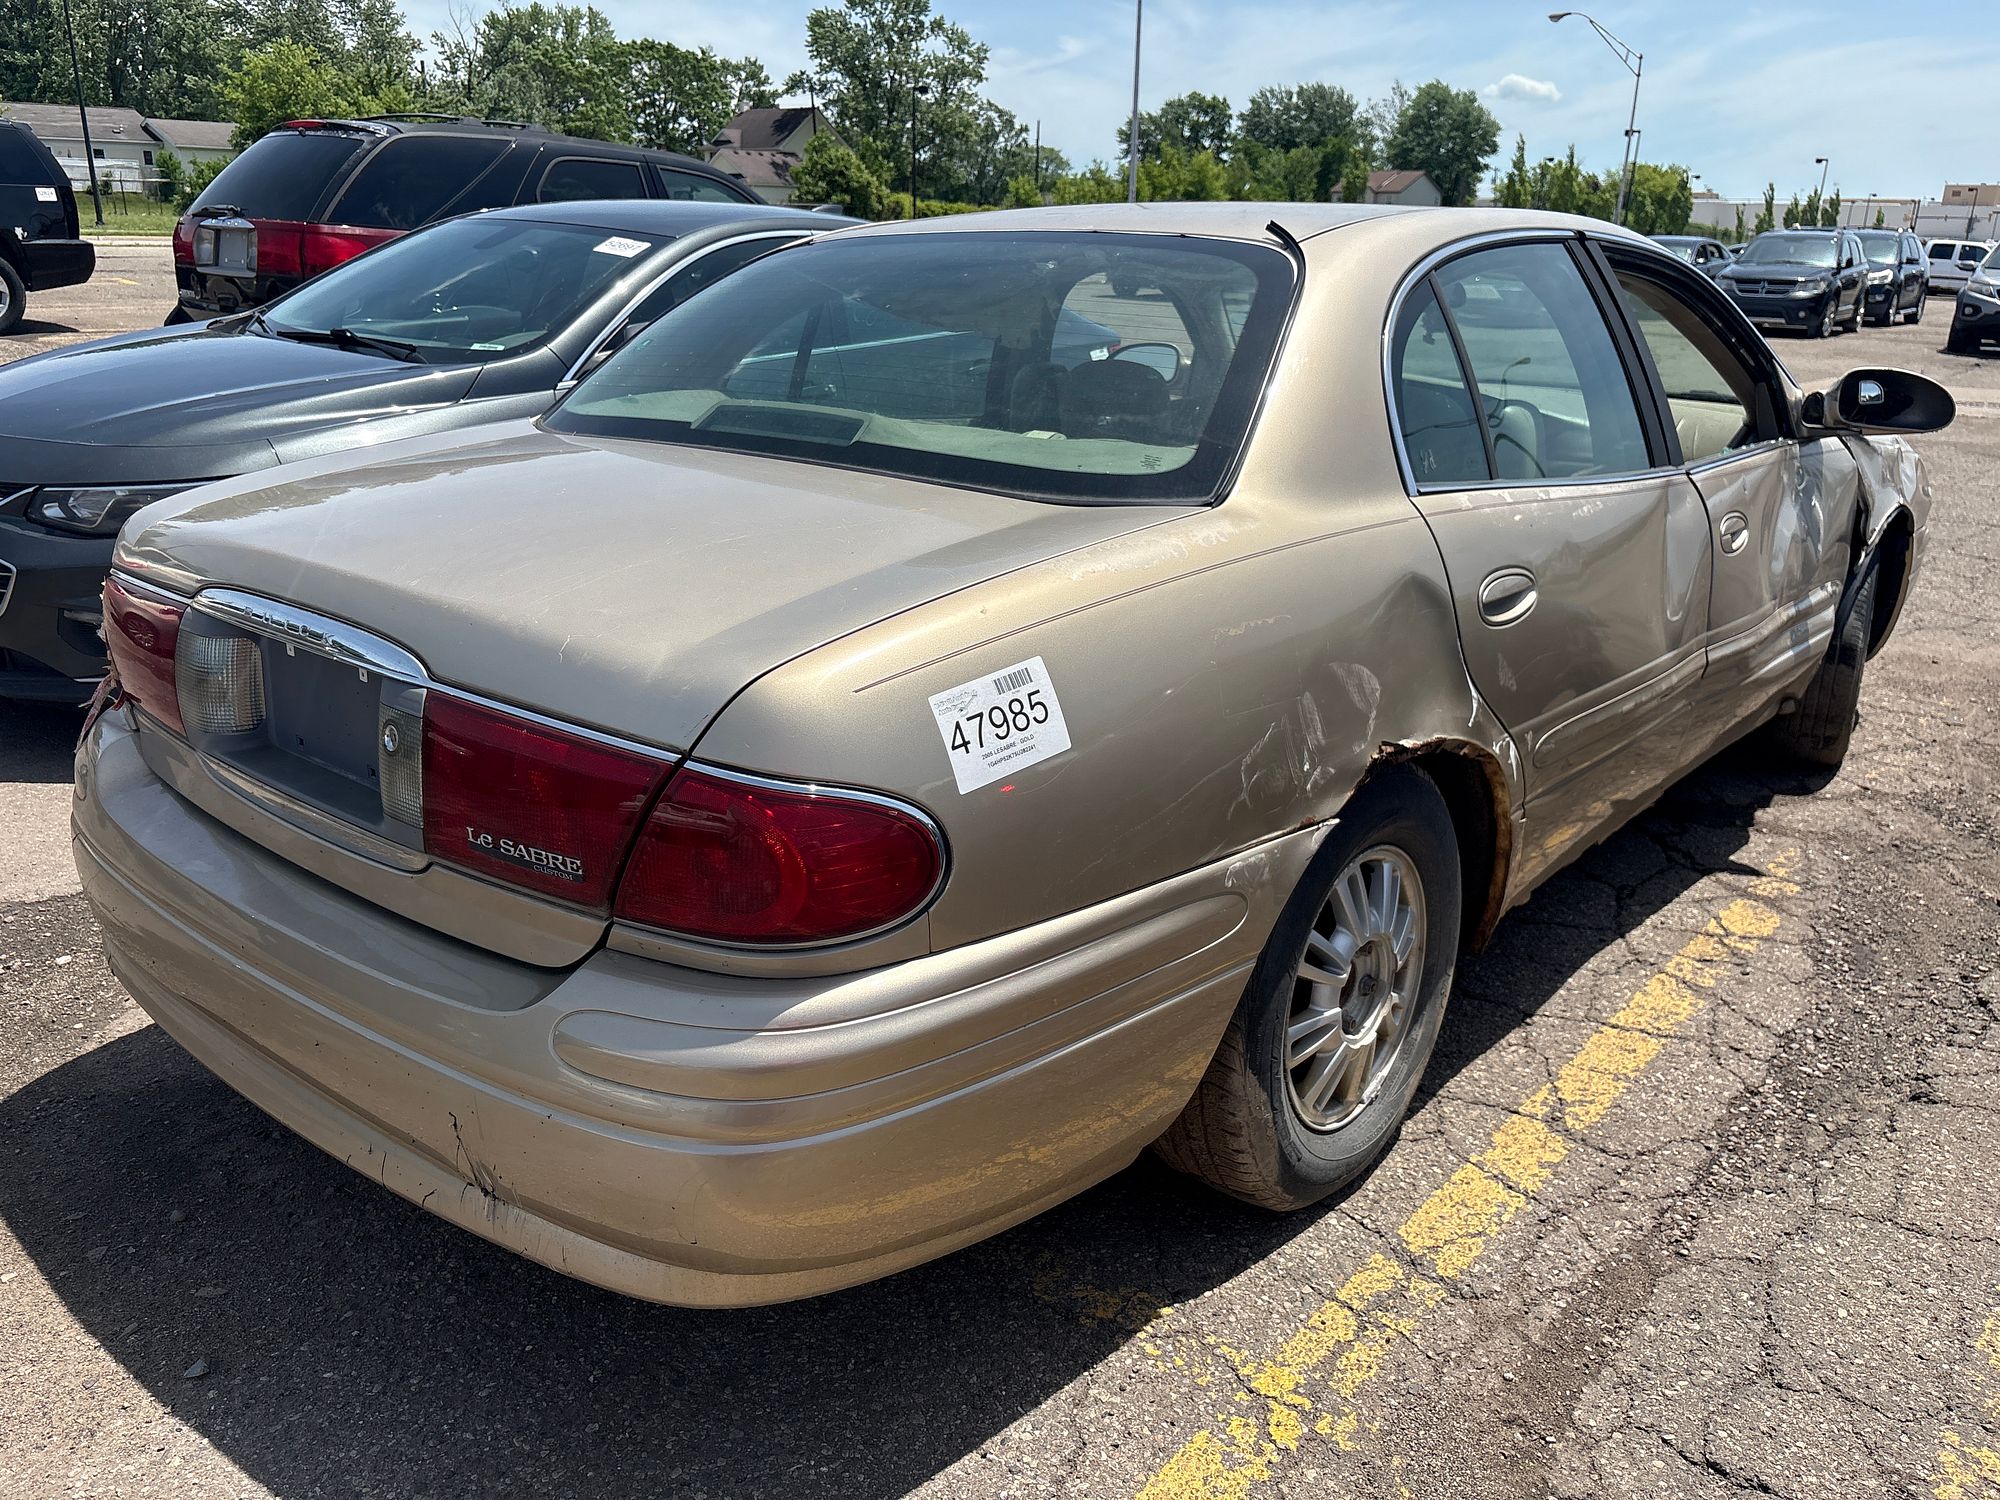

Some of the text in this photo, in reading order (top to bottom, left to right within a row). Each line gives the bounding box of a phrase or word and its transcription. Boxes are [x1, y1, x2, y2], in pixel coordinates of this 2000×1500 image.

[951, 689, 1048, 754] 47985
[993, 741, 1017, 755] LESABRE
[1020, 734, 1034, 744] GOLD
[466, 826, 584, 875] Le SABRE
[533, 864, 575, 881] CUSTOM
